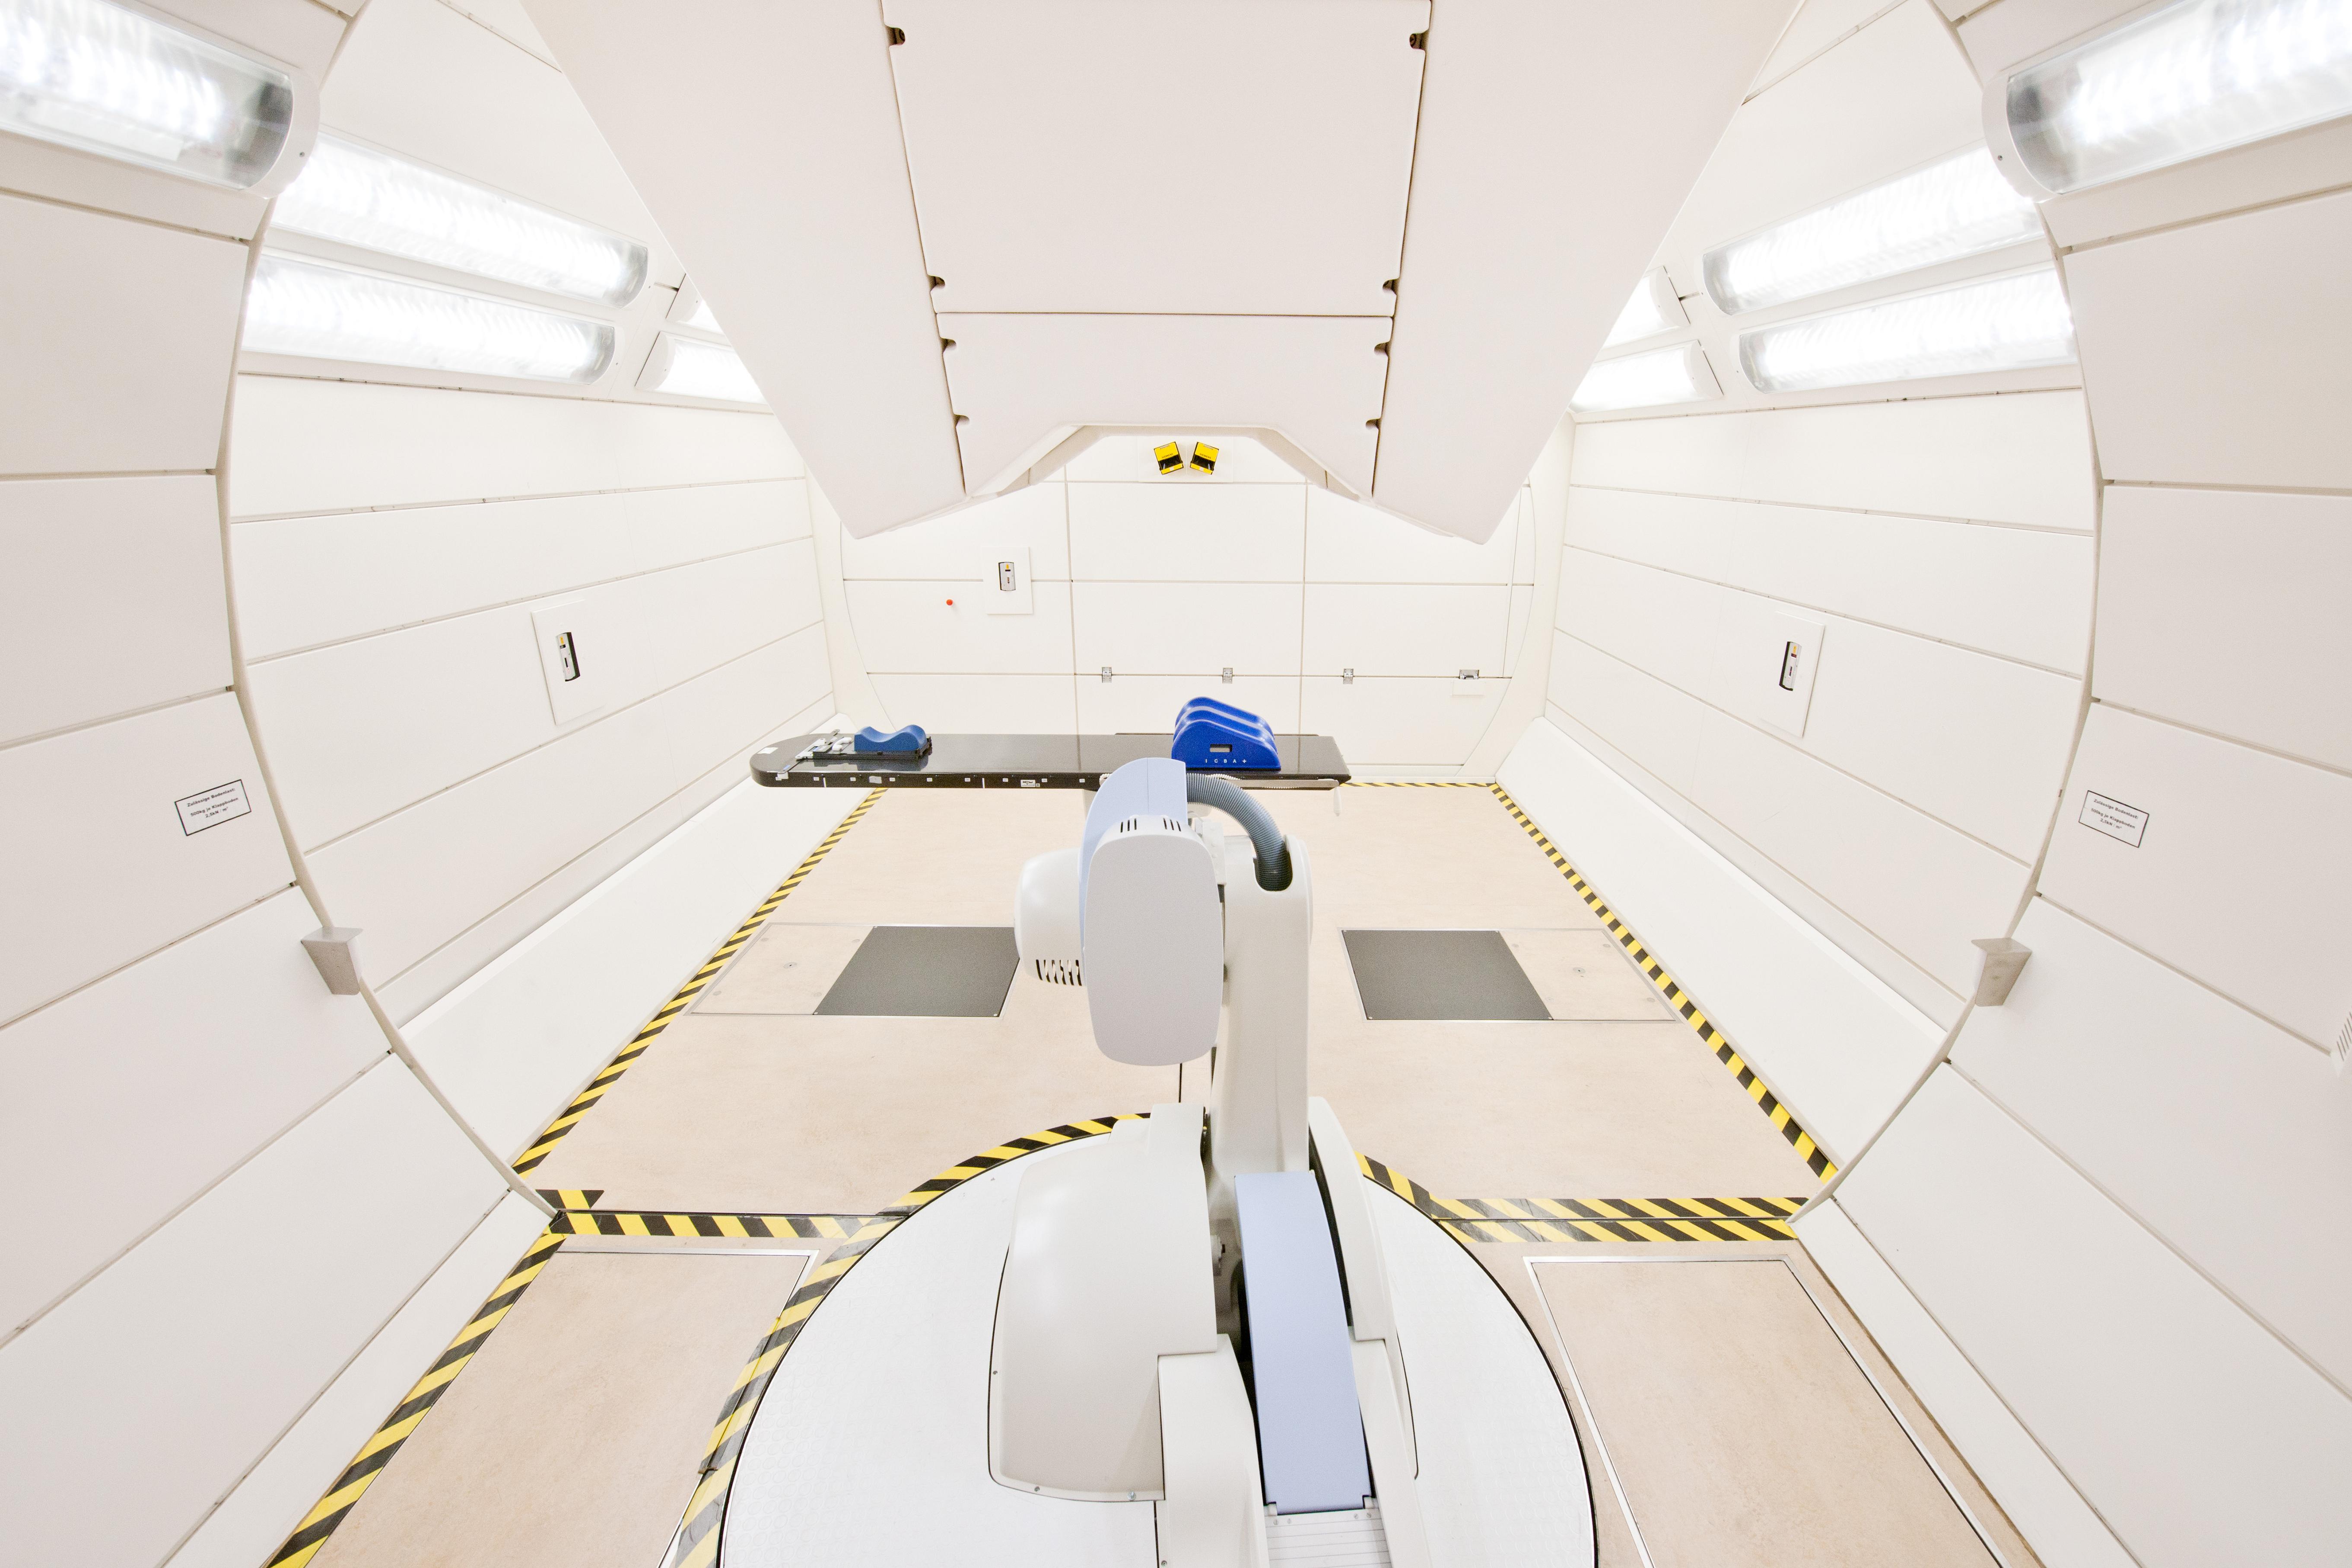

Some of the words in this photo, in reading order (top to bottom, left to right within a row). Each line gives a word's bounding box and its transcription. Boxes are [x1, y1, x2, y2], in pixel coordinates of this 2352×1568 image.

[211, 788, 235, 798] Bodenlast:
[212, 797, 238, 809] Klappboden
[2091, 808, 2104, 817] 500kg
